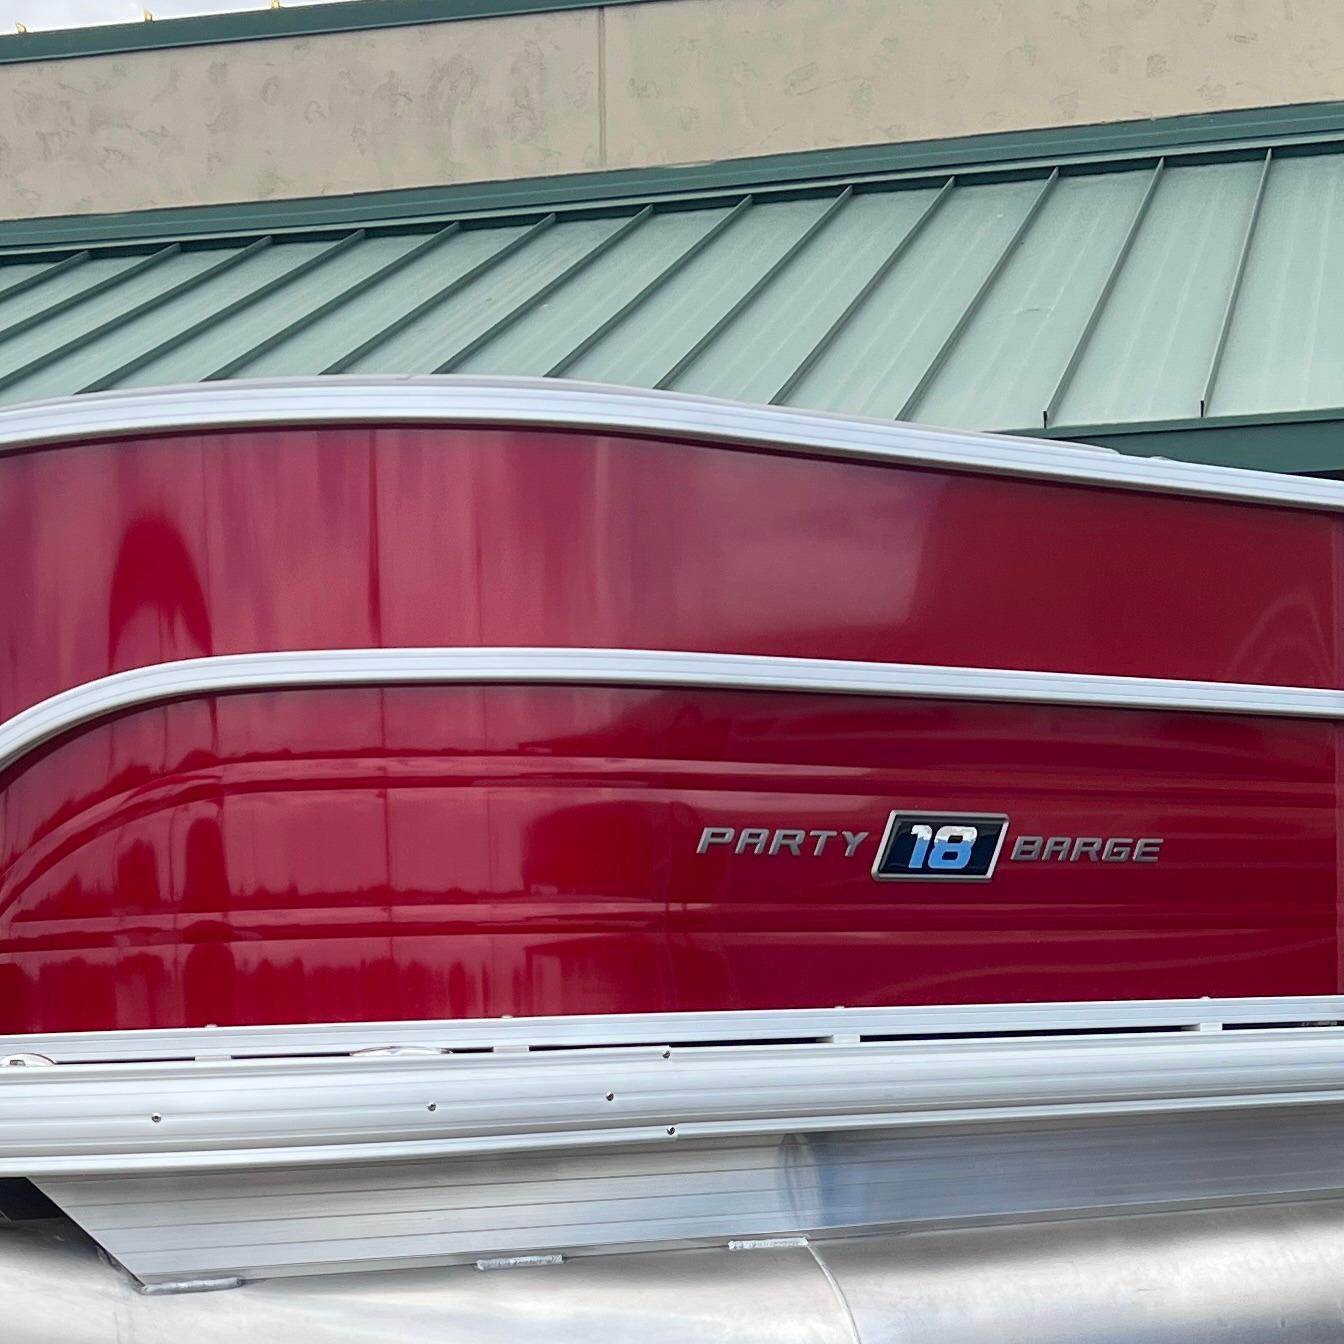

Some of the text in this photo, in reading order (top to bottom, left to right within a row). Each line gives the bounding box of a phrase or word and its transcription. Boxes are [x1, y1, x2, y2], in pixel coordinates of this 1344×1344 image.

[696, 824, 1164, 870] PARTY 18 BARGE
